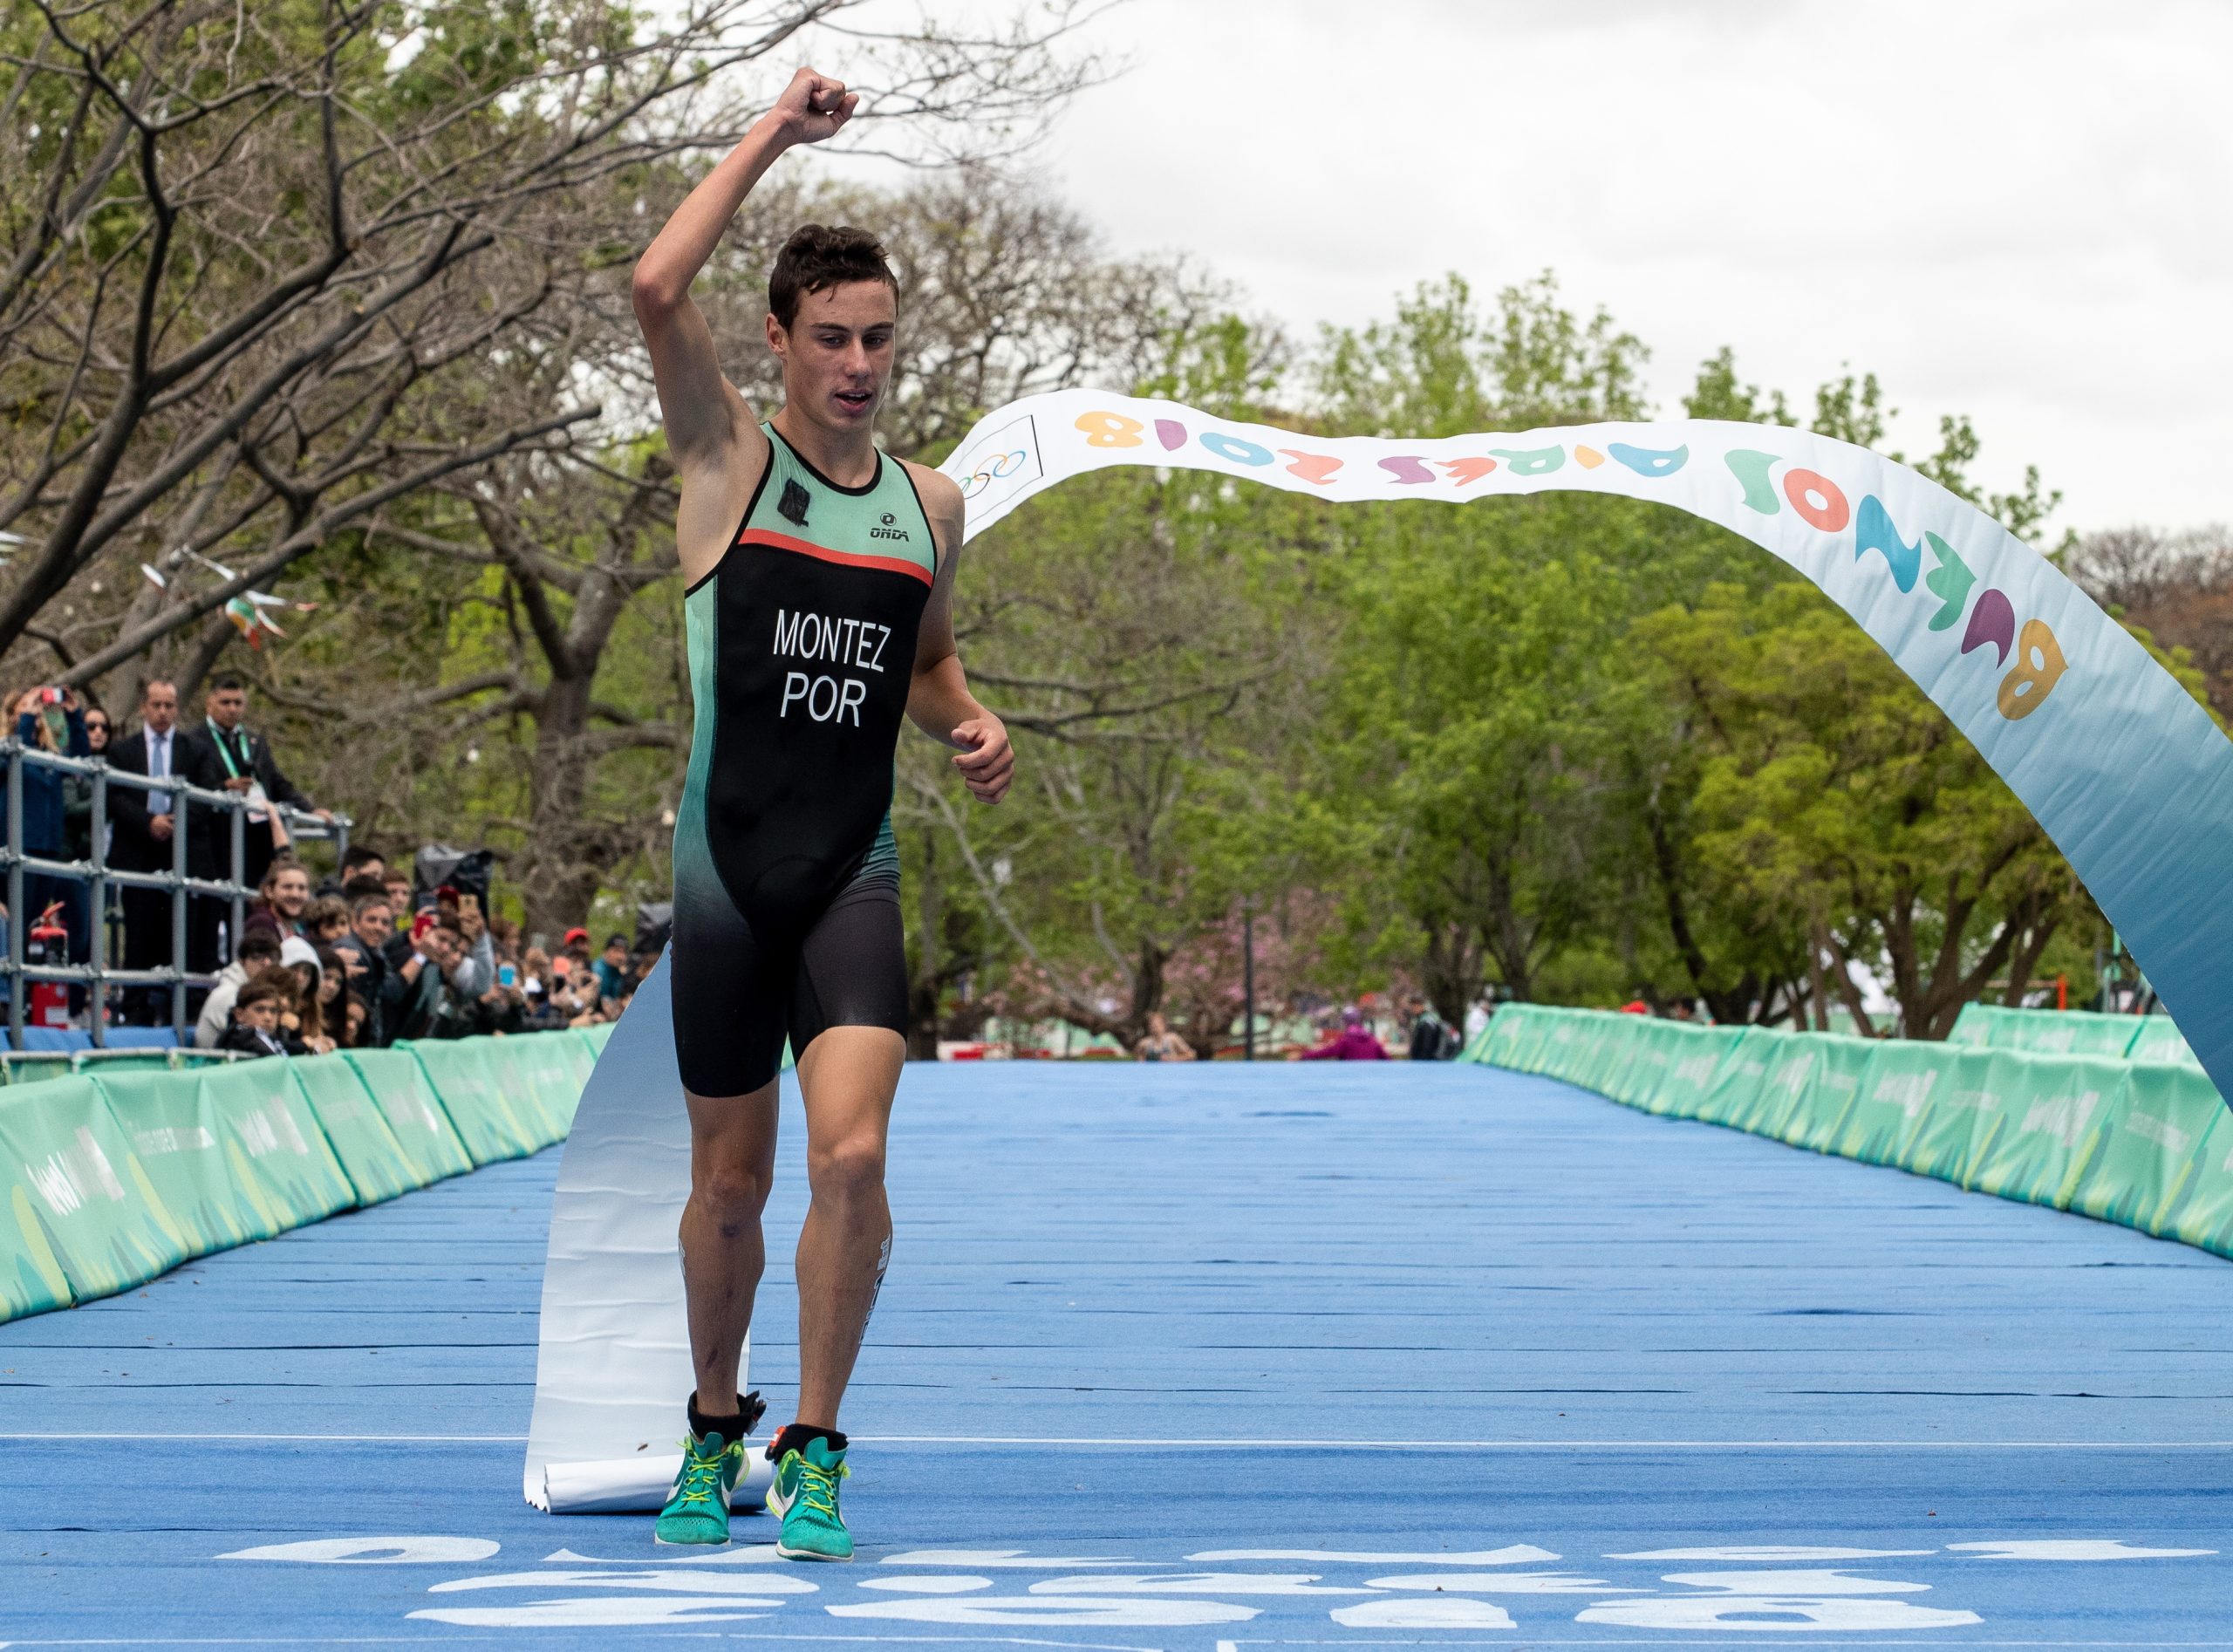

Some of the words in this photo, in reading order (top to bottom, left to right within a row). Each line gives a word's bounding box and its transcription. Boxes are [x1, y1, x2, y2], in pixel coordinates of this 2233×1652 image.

[870, 527, 910, 543] ONDA
[773, 609, 891, 672] MONTEZ
[780, 672, 867, 727] POR
[404, 1597, 1986, 1631] 2018
